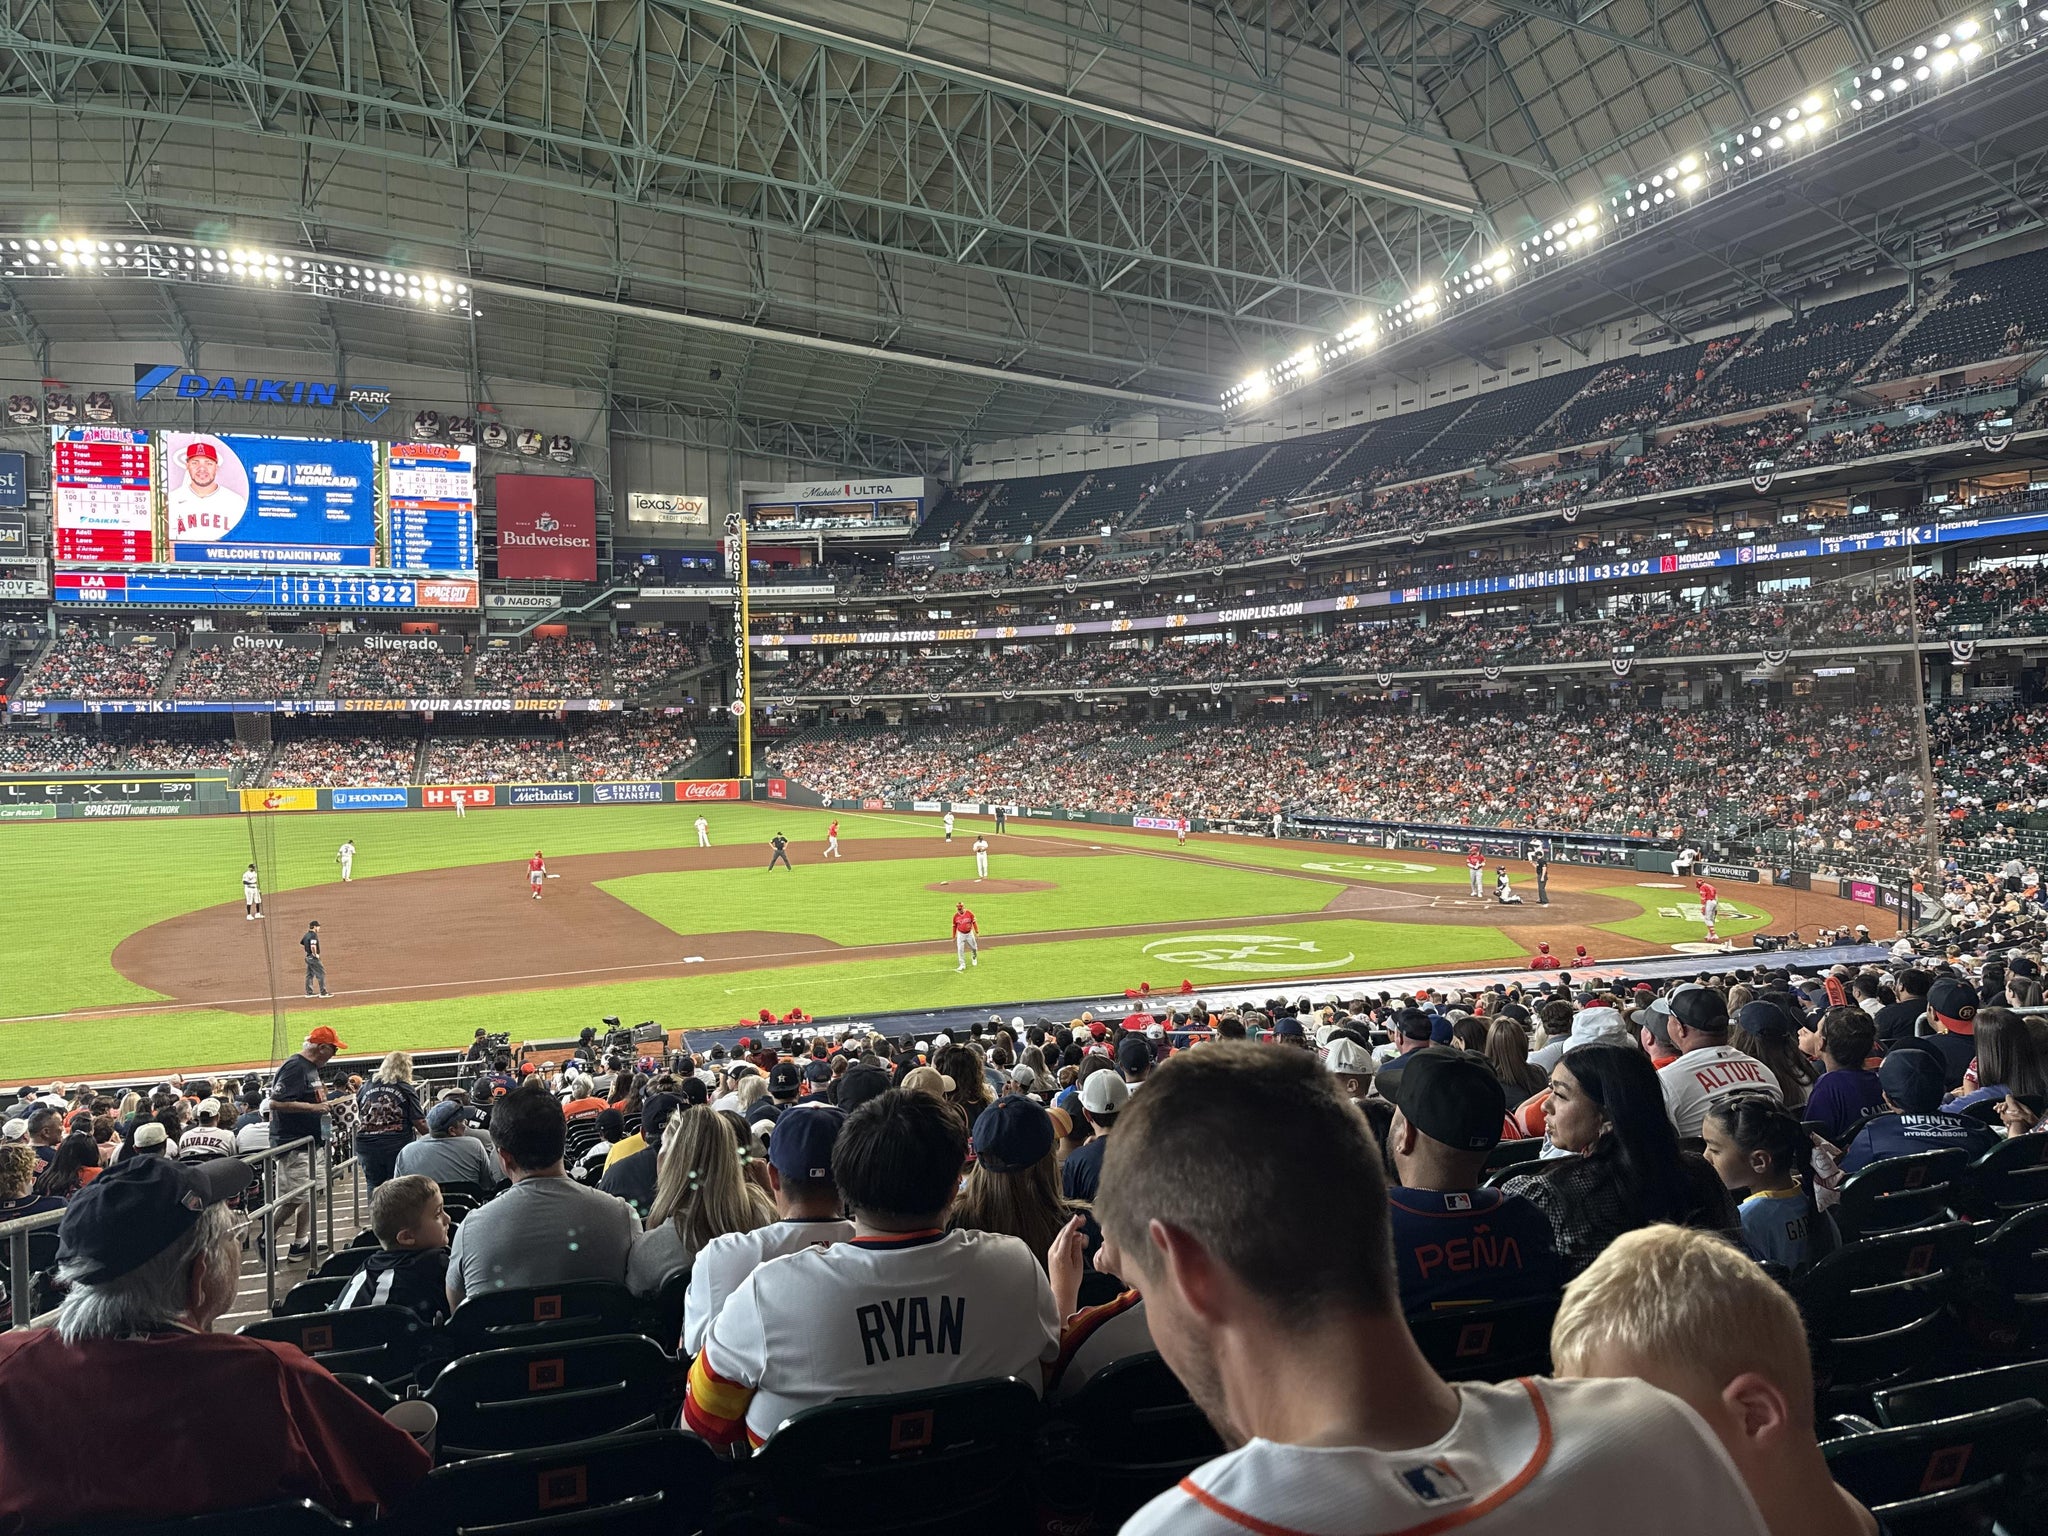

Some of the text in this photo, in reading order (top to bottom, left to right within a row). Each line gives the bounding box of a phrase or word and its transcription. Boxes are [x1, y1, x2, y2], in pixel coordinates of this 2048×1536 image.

[176, 374, 337, 406] DAIKIN
[350, 390, 392, 404] PARK
[9, 395, 34, 413] 33
[47, 393, 74, 411] 34
[85, 392, 112, 409] 42
[415, 410, 438, 426] 49
[450, 415, 472, 432] 24
[83, 428, 134, 444] ANGELS
[490, 422, 500, 438] 5
[523, 429, 534, 444] 7
[552, 435, 571, 451] 13
[253, 463, 286, 485] 10
[294, 475, 358, 488] MONCADA
[802, 484, 893, 499] Michelob ULTRA
[633, 494, 704, 516] Texas Bay
[658, 514, 679, 522] CREDIT
[1940, 520, 1979, 530] PITCH TYPE
[1824, 536, 1844, 544] BALLS
[1880, 529, 1900, 537] TOTAL
[1906, 527, 1932, 545] K 2
[1756, 544, 1777, 553] IMAI
[1828, 537, 1896, 553] 13 11 24
[206, 548, 341, 562] WELCOME TO DAIKIN PARK
[1678, 550, 1721, 564] MONCADA
[80, 576, 105, 586] LAA
[1508, 578, 1515, 588] R
[1528, 576, 1534, 586] H
[1548, 574, 1554, 583] E
[80, 589, 106, 600] HOU
[367, 585, 412, 602] 3 2 2
[424, 586, 470, 598] SPACE CITY
[508, 597, 552, 606] NABORS
[1218, 602, 1303, 623] SCHNPLUS.COM
[232, 635, 284, 650] Chevy
[364, 636, 438, 650] Silverado
[811, 628, 978, 644] STREAM YOUR ASTROS DIRECT
[153, 701, 164, 712] K
[344, 700, 406, 711] STREAM
[411, 700, 450, 711] YOUR
[453, 700, 511, 711] ASTROS
[514, 700, 566, 711] DIRECT
[172, 783, 192, 792] 370
[612, 784, 650, 792] ENERGY
[348, 794, 406, 802] HONDA
[428, 789, 490, 804] H-E-B
[515, 790, 574, 802] Methodist
[612, 792, 660, 800] TRANSFER
[16, 809, 43, 817] Rental
[84, 804, 180, 816] SPACE CITY HOME NETWORK
[1710, 866, 1750, 878] WOODFOREST
[1855, 890, 1872, 898] reliant
[1891, 898, 1909, 910] LEUS
[1695, 1061, 1767, 1094] ALTUVE
[1904, 1130, 1968, 1138] HYDROCARBONS
[180, 1136, 222, 1149] ALVAREZ
[1414, 1223, 1524, 1280] PEÑA
[856, 1295, 966, 1367] RYAN
